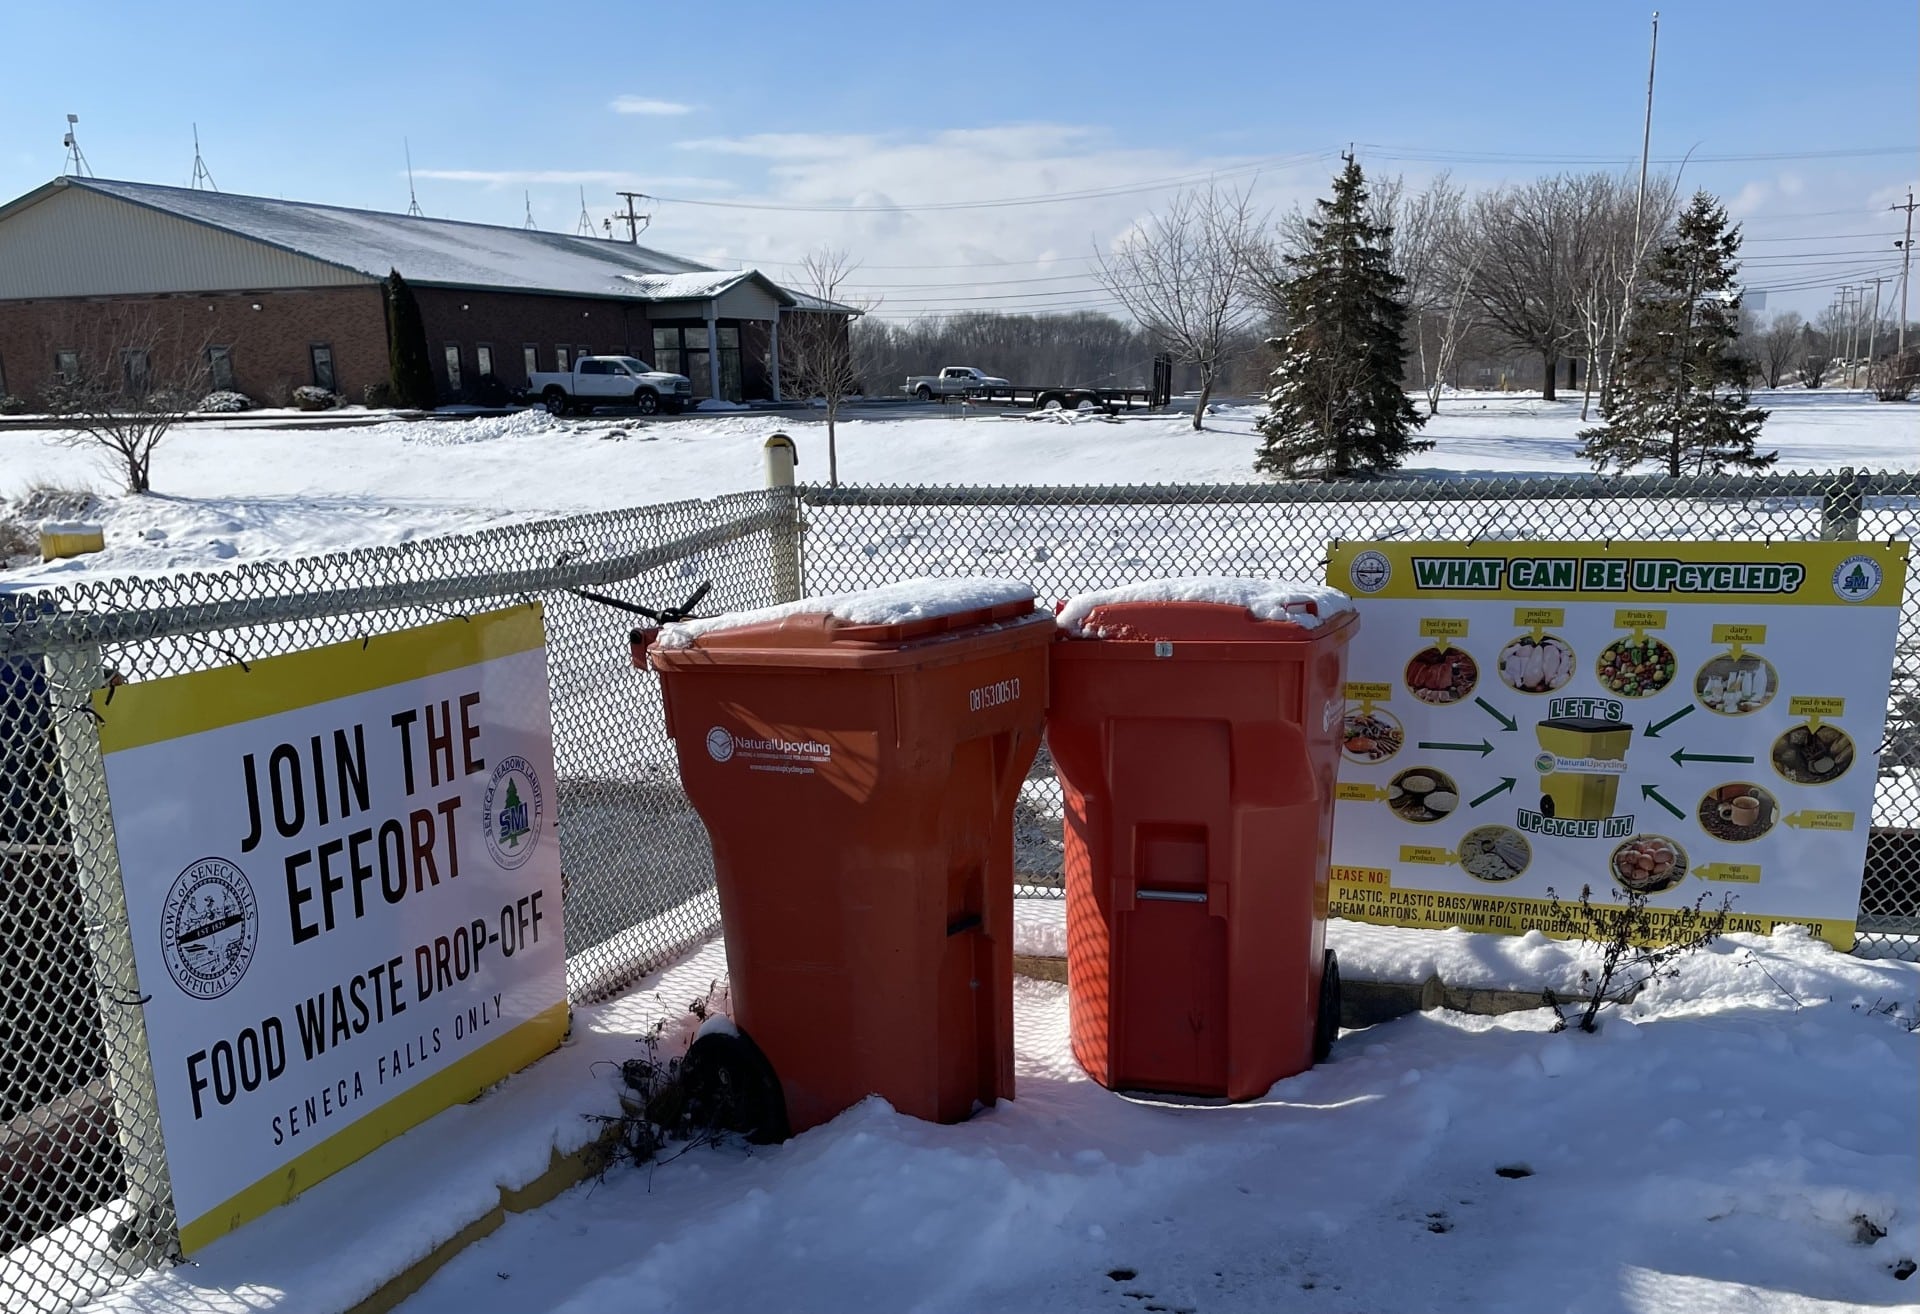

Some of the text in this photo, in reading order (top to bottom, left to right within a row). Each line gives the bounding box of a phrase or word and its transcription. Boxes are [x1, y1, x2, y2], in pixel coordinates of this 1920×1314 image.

[1411, 557, 1507, 591] WHAT
[1508, 557, 1579, 592] CAN
[1579, 557, 1628, 593] BE
[1844, 576, 1870, 588] SMI
[1524, 617, 1553, 625] products
[1527, 610, 1551, 619] poultry
[1622, 619, 1658, 628] vegetables
[1430, 627, 1458, 636] products
[1729, 626, 1748, 636] dairy
[970, 677, 1020, 712] 0815300513
[1791, 698, 1814, 707] bread
[1820, 699, 1842, 709] wheat
[1549, 697, 1623, 722] LET'S
[1800, 706, 1832, 714] products
[735, 736, 831, 756] NaturalUpcycling
[241, 723, 371, 853] JOIN
[391, 691, 485, 796] THE
[485, 758, 542, 838] SENECA MEADOWS LANDFILL
[499, 801, 529, 838] SMI
[1810, 819, 1842, 828] products
[1816, 812, 1838, 820] coffee
[1603, 815, 1635, 838] IT!
[1409, 854, 1435, 862] products
[284, 795, 462, 946] EFFORT
[1330, 868, 1388, 884] LEASE NO:
[1718, 872, 1749, 880] products
[165, 863, 255, 951] TOWN of SENECA FALLS
[1329, 901, 1365, 915] CREAM
[1368, 904, 1421, 922] CARTONS,
[1425, 909, 1485, 926] ALUMINUM
[1489, 916, 1516, 930] FOIL,
[1339, 888, 1386, 904] PLASTIC,
[1390, 892, 1433, 908] PLASTIC
[1700, 916, 1724, 930] AND
[1728, 918, 1765, 934] CANS,
[197, 926, 210, 938] EST
[179, 943, 252, 994] OFFICIAL SEAL
[186, 889, 543, 1121] FOOD WASTE DROP-OFF
[271, 993, 502, 1147] SENECA FALLS ONLY
